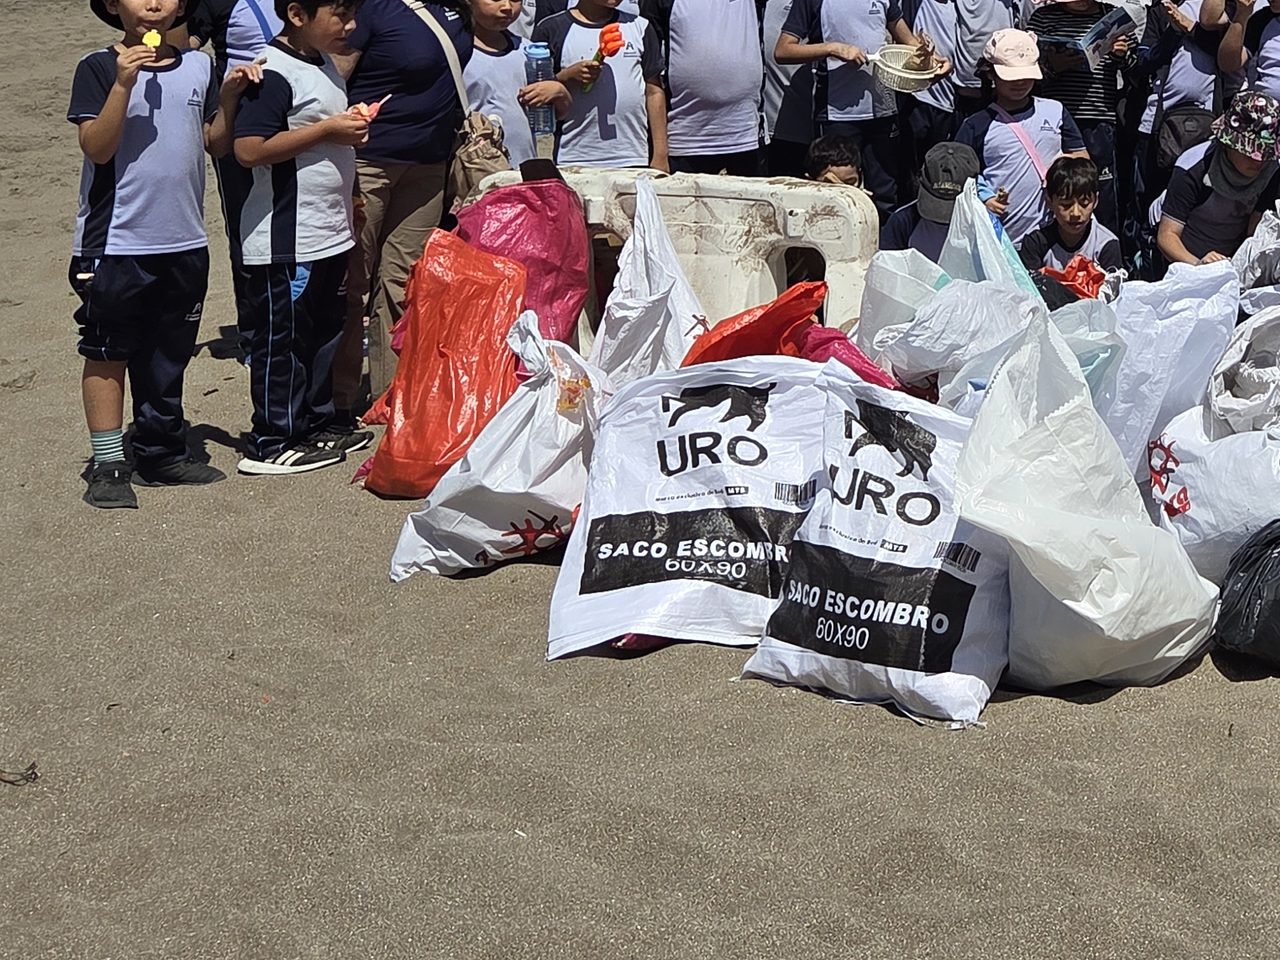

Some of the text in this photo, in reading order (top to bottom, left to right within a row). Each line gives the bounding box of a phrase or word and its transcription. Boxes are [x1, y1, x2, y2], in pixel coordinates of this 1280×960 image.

[657, 431, 768, 477] URO
[829, 464, 940, 526] URO
[598, 539, 792, 563] SACO ESCOMBR
[665, 558, 746, 579] 60X90
[788, 579, 949, 634] SACO ESCOMBRO
[816, 616, 870, 650] 60X90
